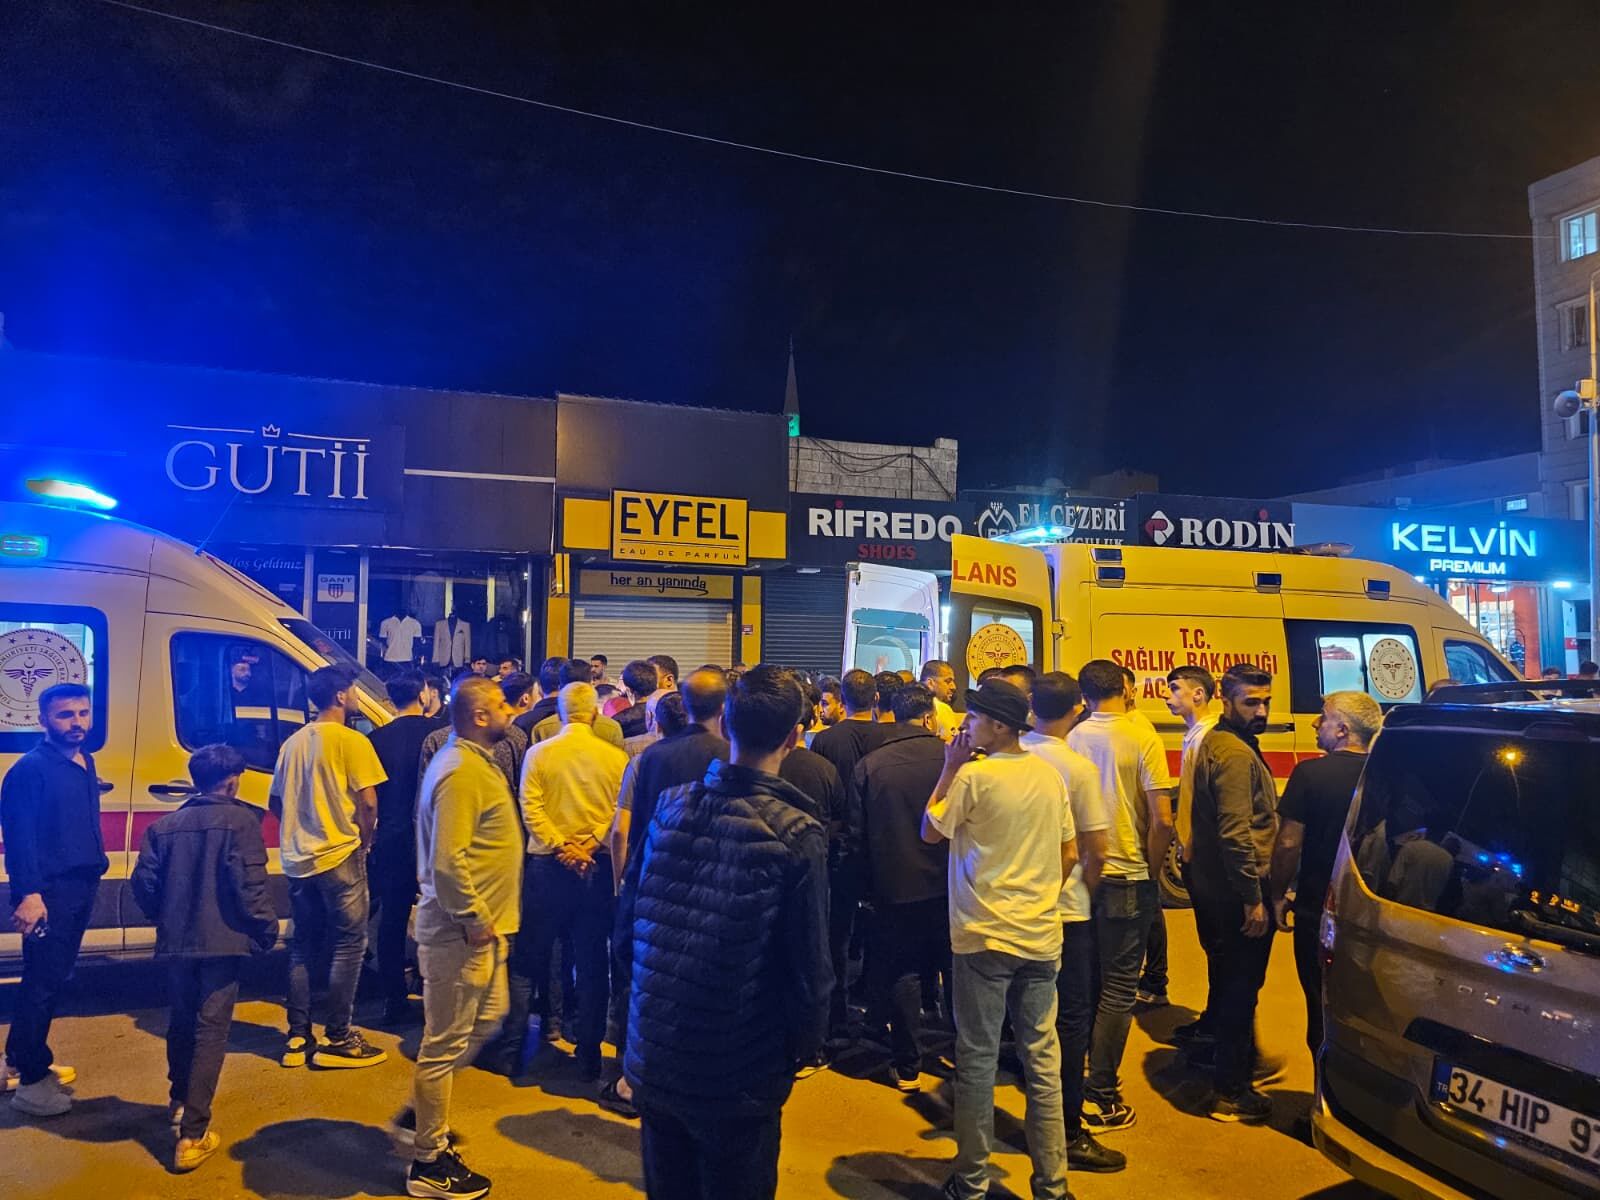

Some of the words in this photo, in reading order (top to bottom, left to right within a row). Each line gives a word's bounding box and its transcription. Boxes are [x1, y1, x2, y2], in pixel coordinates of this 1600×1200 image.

[620, 496, 740, 541] EYFEL
[1180, 508, 1296, 549] RODİN
[1391, 520, 1537, 557] KELVİN
[685, 551, 740, 560] PARFUM
[857, 543, 917, 561] SHOES
[610, 572, 631, 586] her
[637, 576, 652, 586] an
[953, 559, 1017, 587] LANS
[1429, 559, 1506, 575] PREMIUM
[1179, 628, 1211, 650] T.C.
[1111, 646, 1175, 672] SAĞLIK
[1449, 1072, 1486, 1113] 34
[1500, 1089, 1550, 1134] HIP
